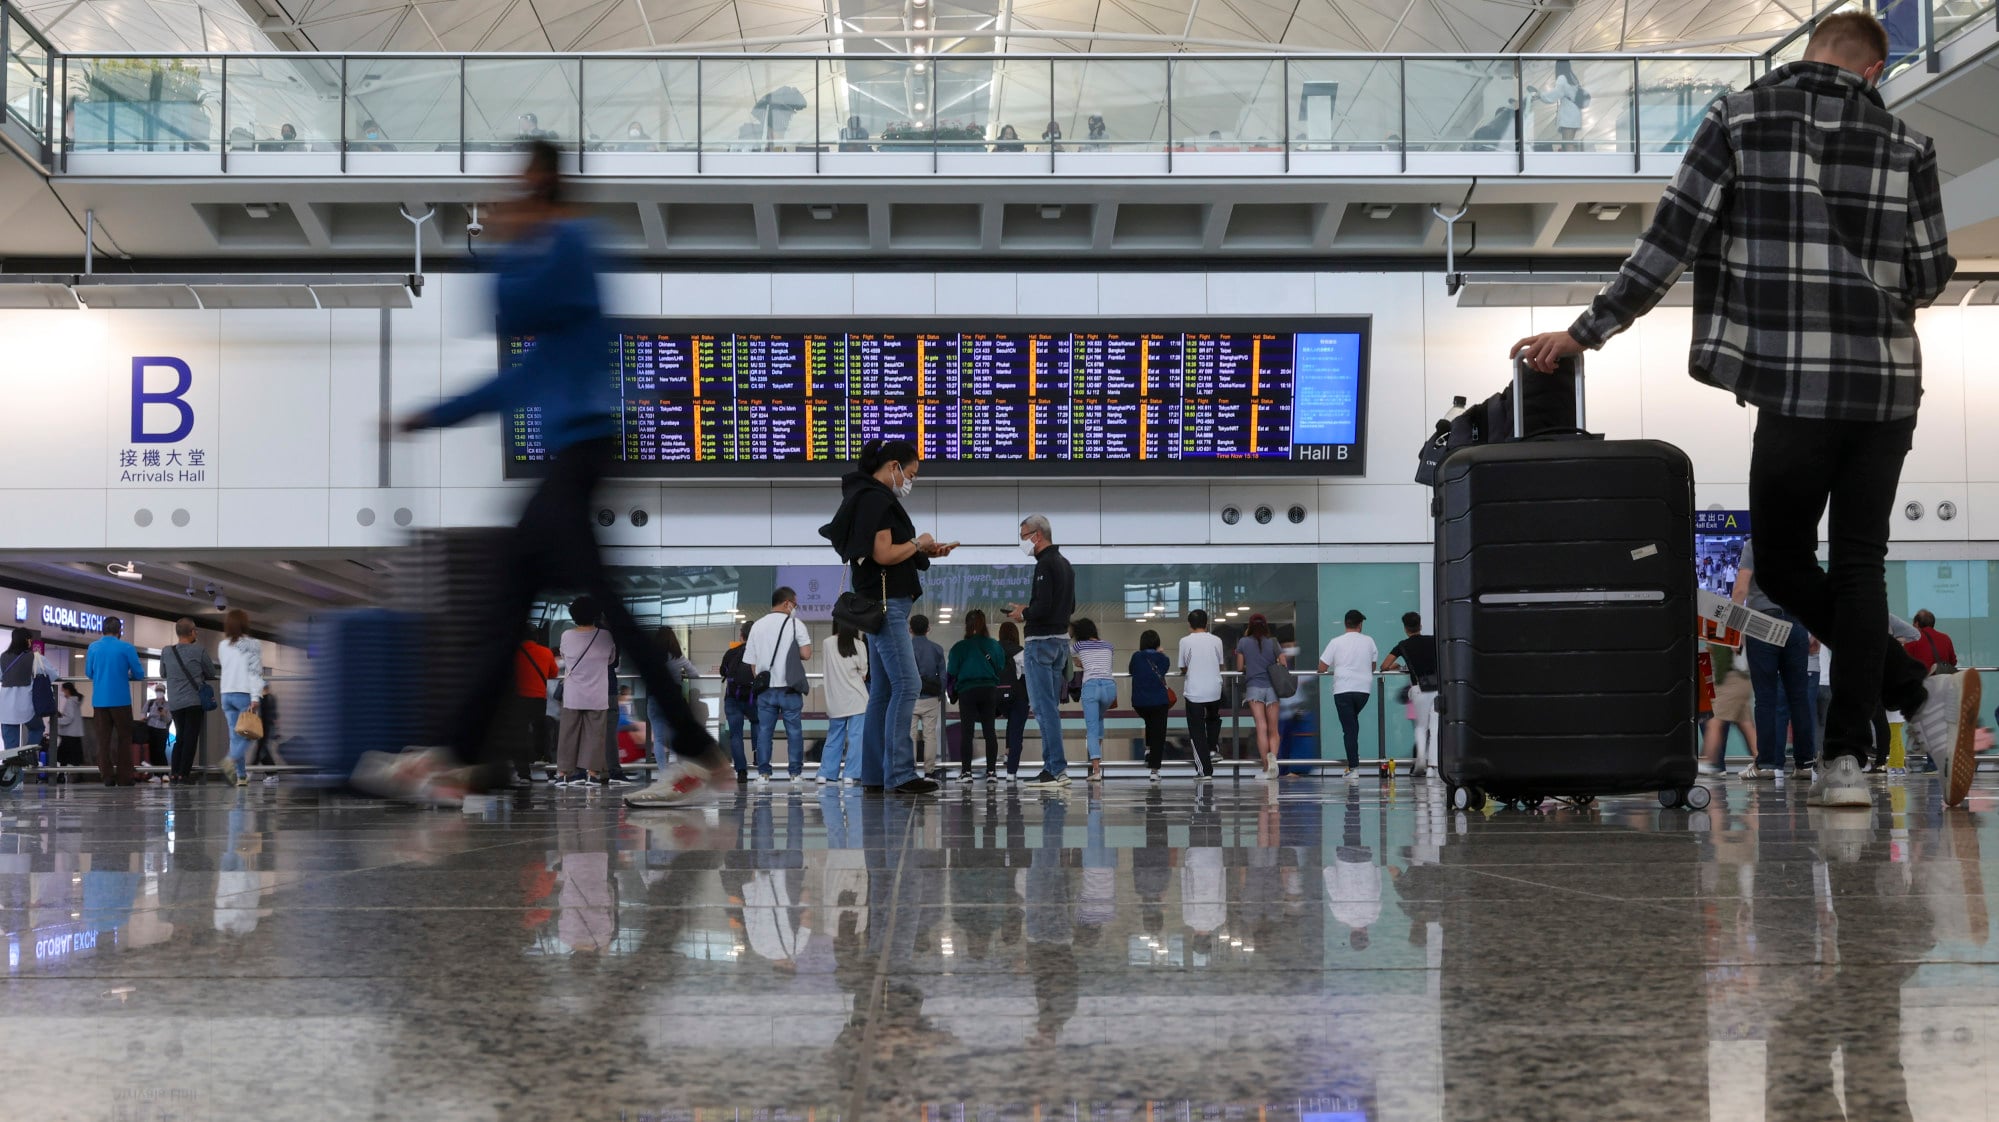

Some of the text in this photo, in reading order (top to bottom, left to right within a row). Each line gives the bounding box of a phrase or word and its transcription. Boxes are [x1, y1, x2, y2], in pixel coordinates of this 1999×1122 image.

[131, 356, 194, 443] B
[120, 449, 205, 467] 接機大堂
[1300, 445, 1348, 460] Hall B
[121, 470, 205, 482] Arrivals Hall
[1695, 513, 1724, 522] 堂出口
[1725, 514, 1737, 528] A
[42, 605, 79, 627] GLOBAL
